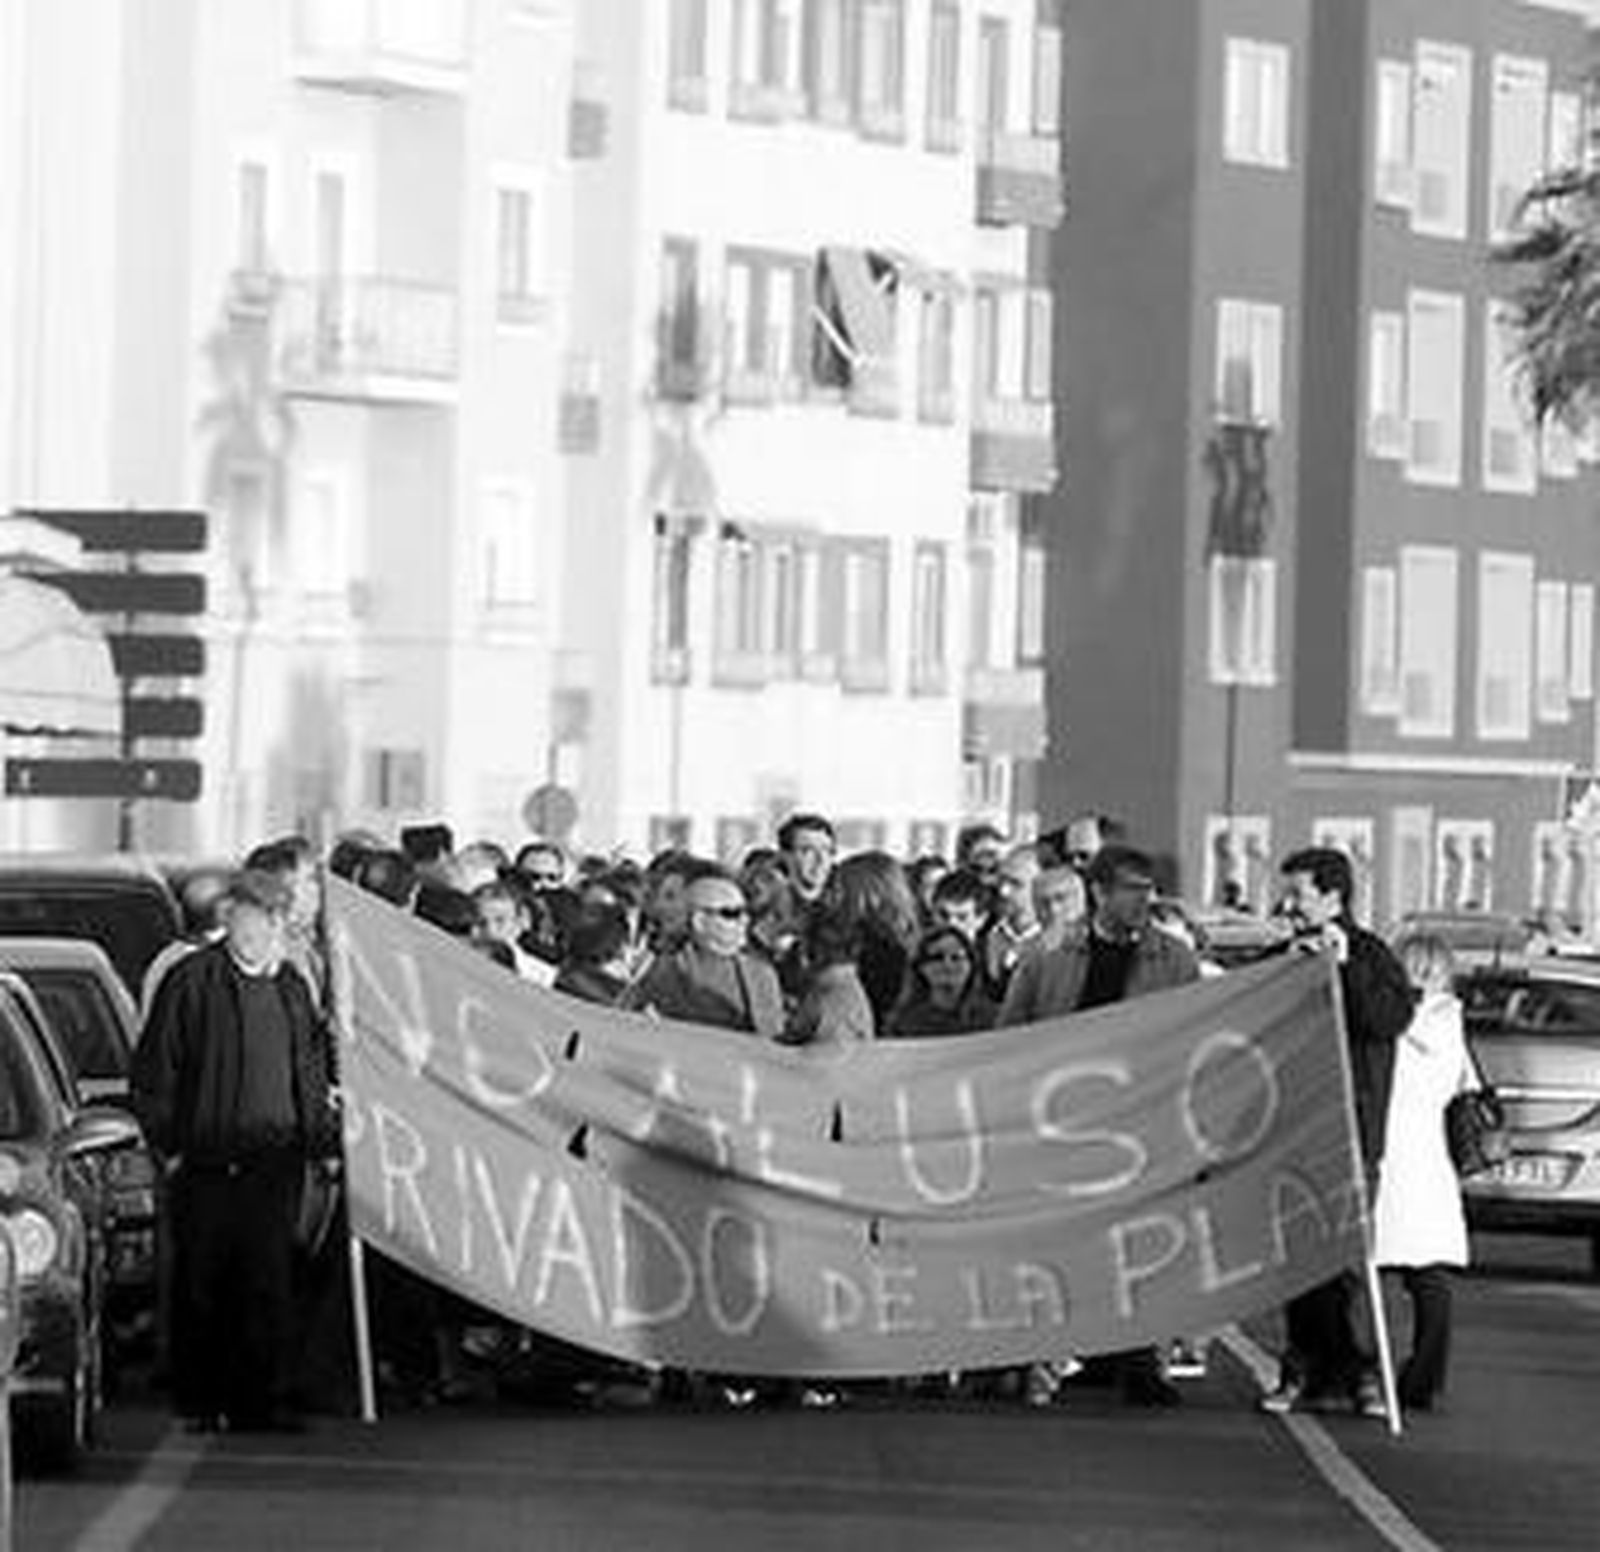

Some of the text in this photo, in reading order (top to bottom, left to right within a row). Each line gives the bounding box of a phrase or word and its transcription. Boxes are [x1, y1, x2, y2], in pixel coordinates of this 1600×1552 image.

[332, 921, 554, 1106] NO
[896, 1031, 1279, 1204] USO
[820, 1264, 934, 1331] DE
[960, 1263, 1064, 1329] LA
